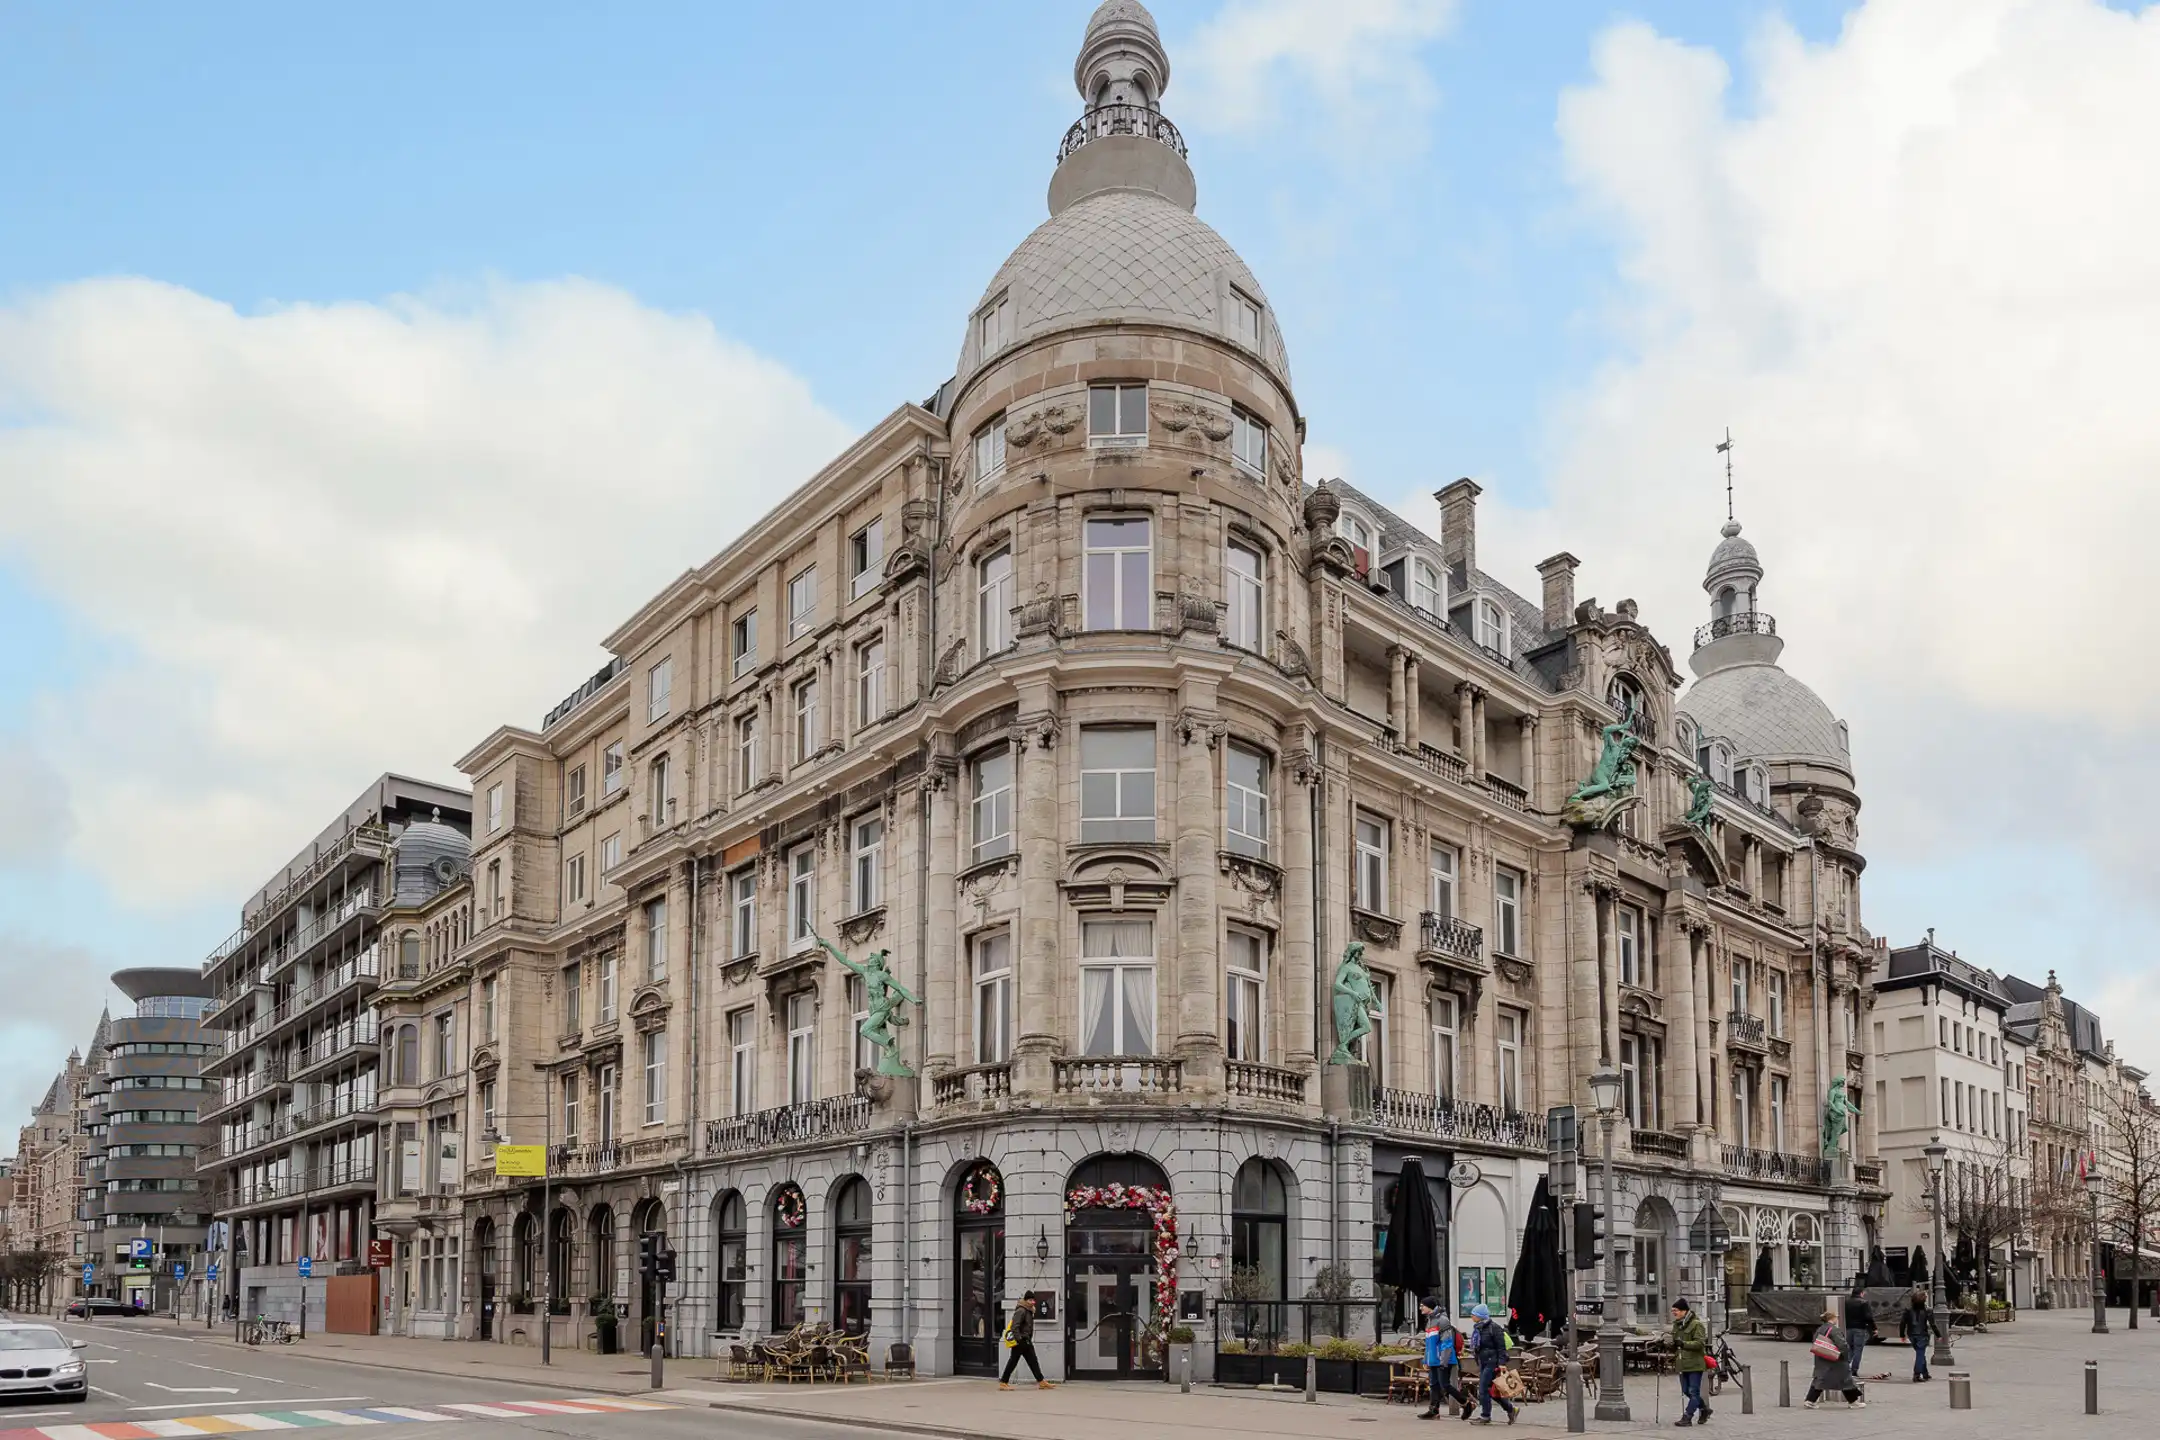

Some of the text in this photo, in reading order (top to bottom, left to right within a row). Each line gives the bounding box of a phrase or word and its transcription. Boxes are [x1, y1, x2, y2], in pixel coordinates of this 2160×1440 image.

[132, 1240, 147, 1255] P
[372, 1241, 382, 1252] R
[302, 1257, 309, 1266] P
